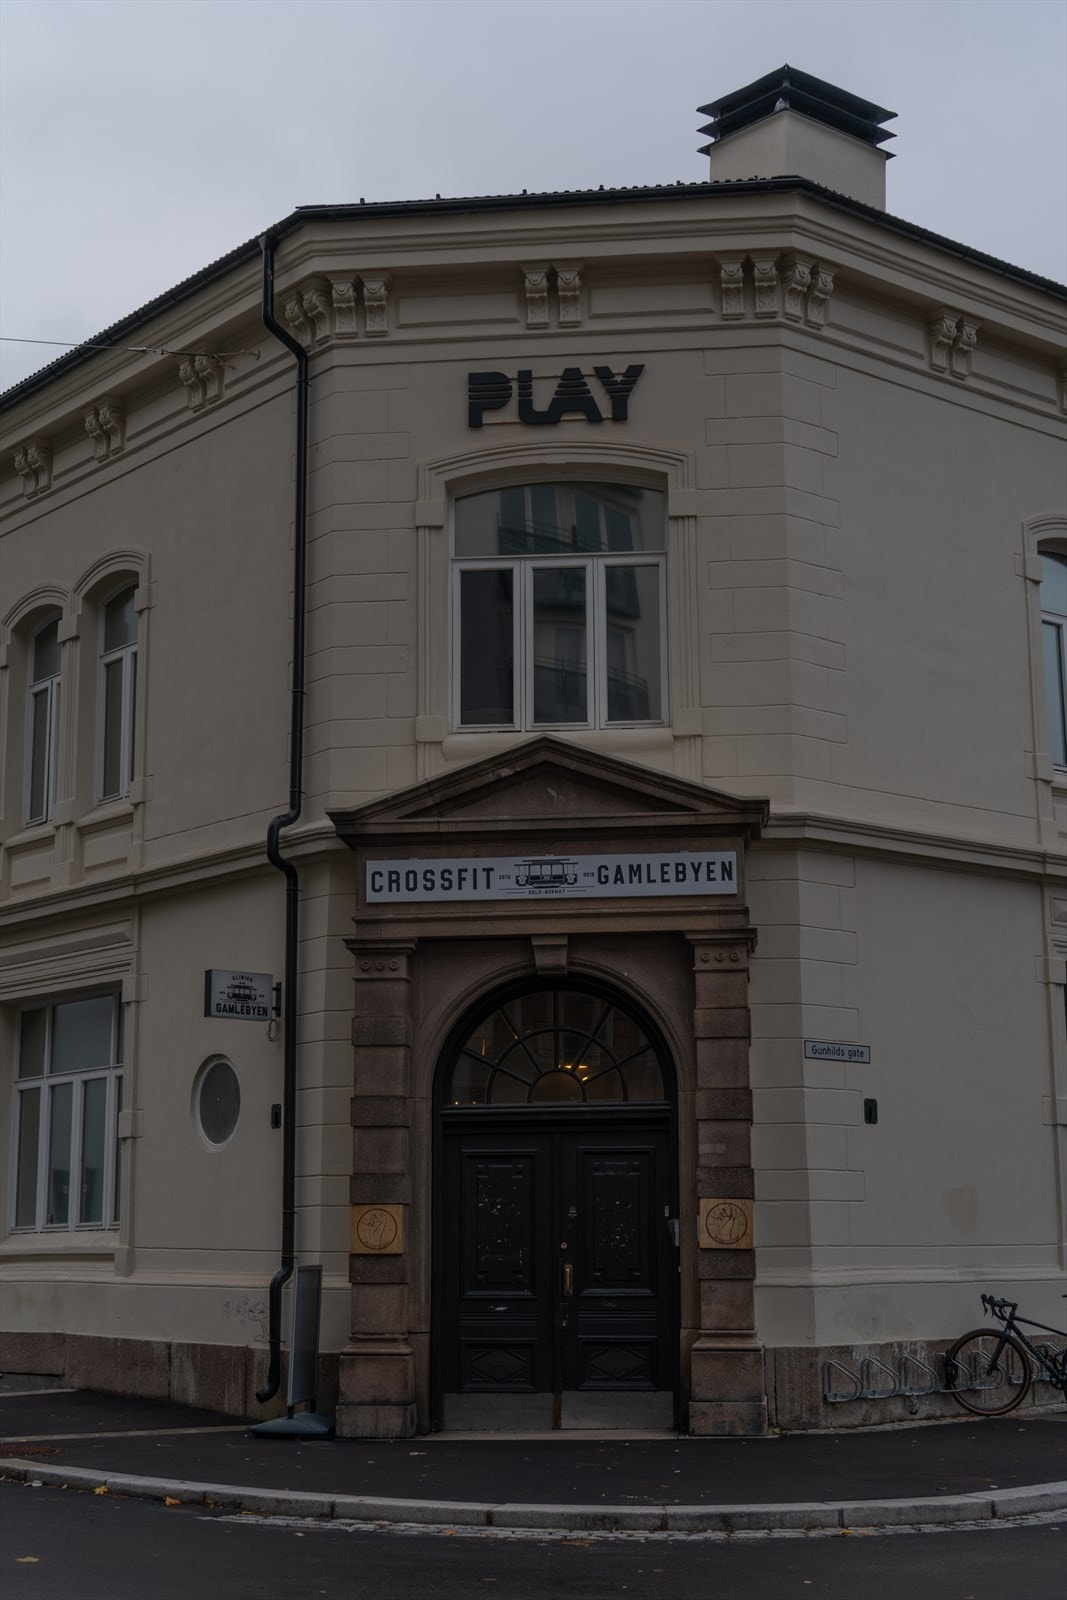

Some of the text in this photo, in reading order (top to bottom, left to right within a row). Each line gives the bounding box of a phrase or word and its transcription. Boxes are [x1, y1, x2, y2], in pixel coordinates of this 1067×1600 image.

[468, 364, 645, 428] PLAY
[371, 867, 495, 893] CROSSFIT
[597, 860, 734, 885] GAMLEBYEN
[216, 1003, 268, 1016] GAMLEBYEN
[811, 1045, 865, 1059] Gunhilds gate
